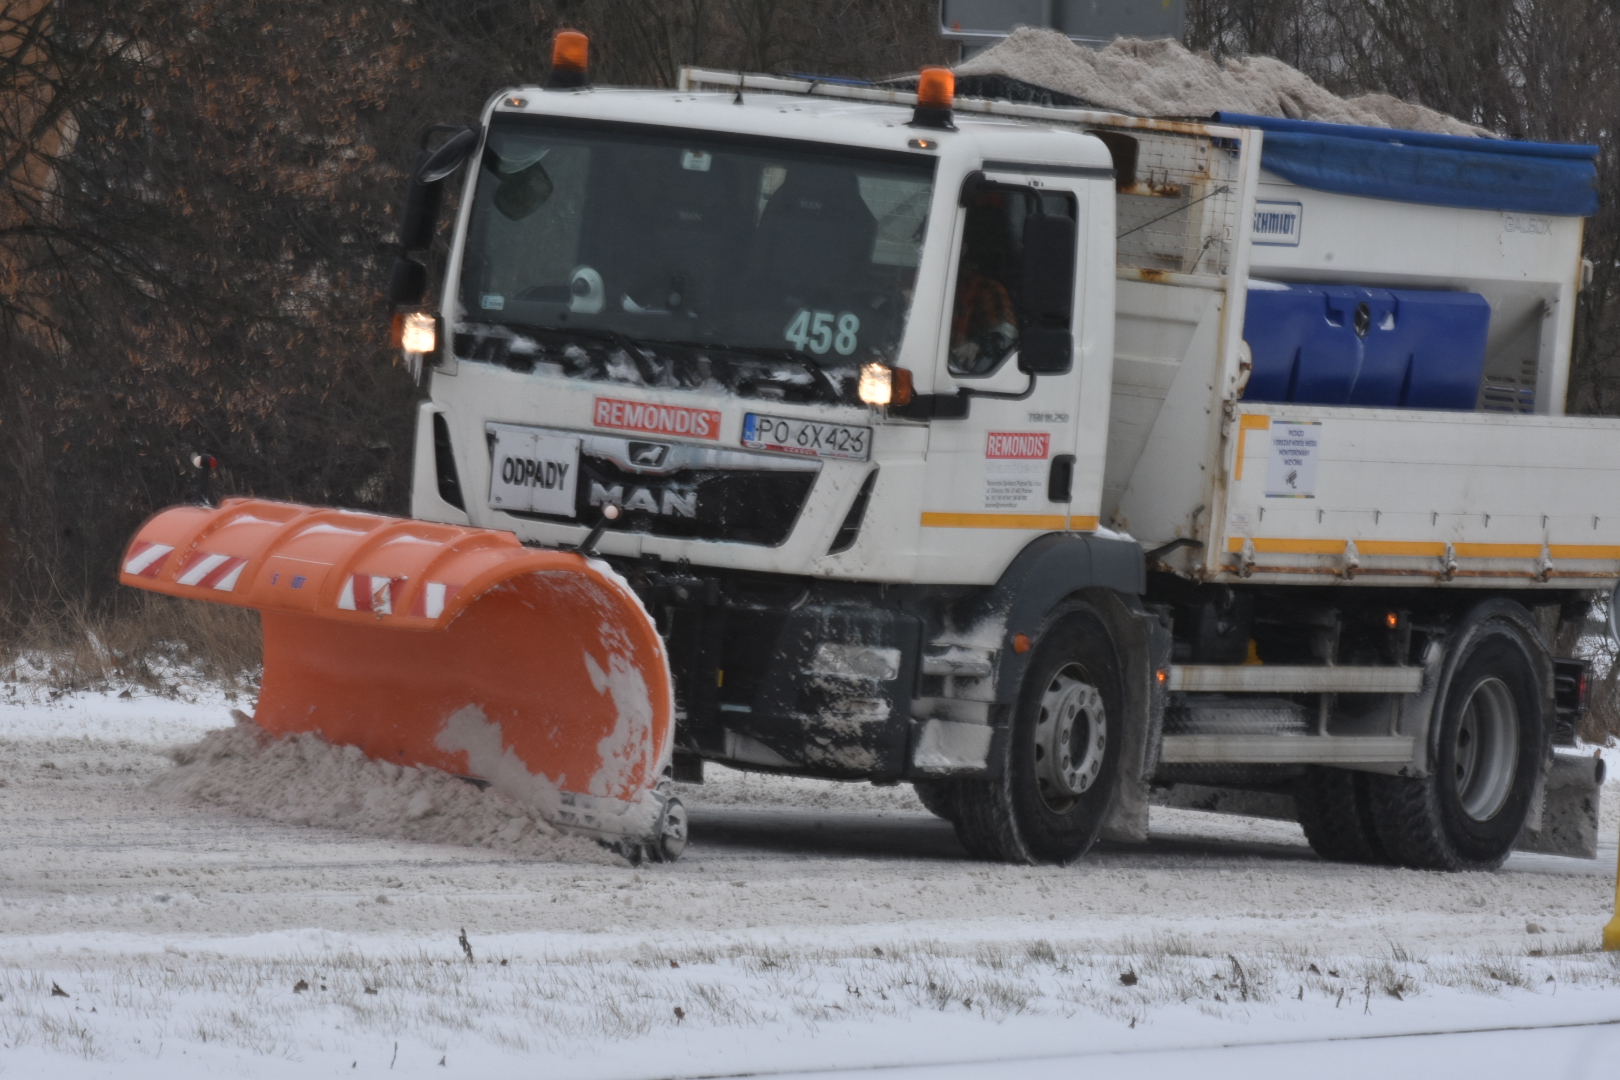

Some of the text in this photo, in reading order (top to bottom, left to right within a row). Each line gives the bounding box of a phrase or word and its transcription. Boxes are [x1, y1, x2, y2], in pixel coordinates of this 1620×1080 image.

[785, 310, 860, 356] 458
[596, 401, 710, 436] REMONDIS
[758, 418, 865, 453] PO 6X426
[987, 435, 1045, 457] REMONDIS
[502, 456, 570, 491] ODPADY
[589, 480, 698, 519] MAN
